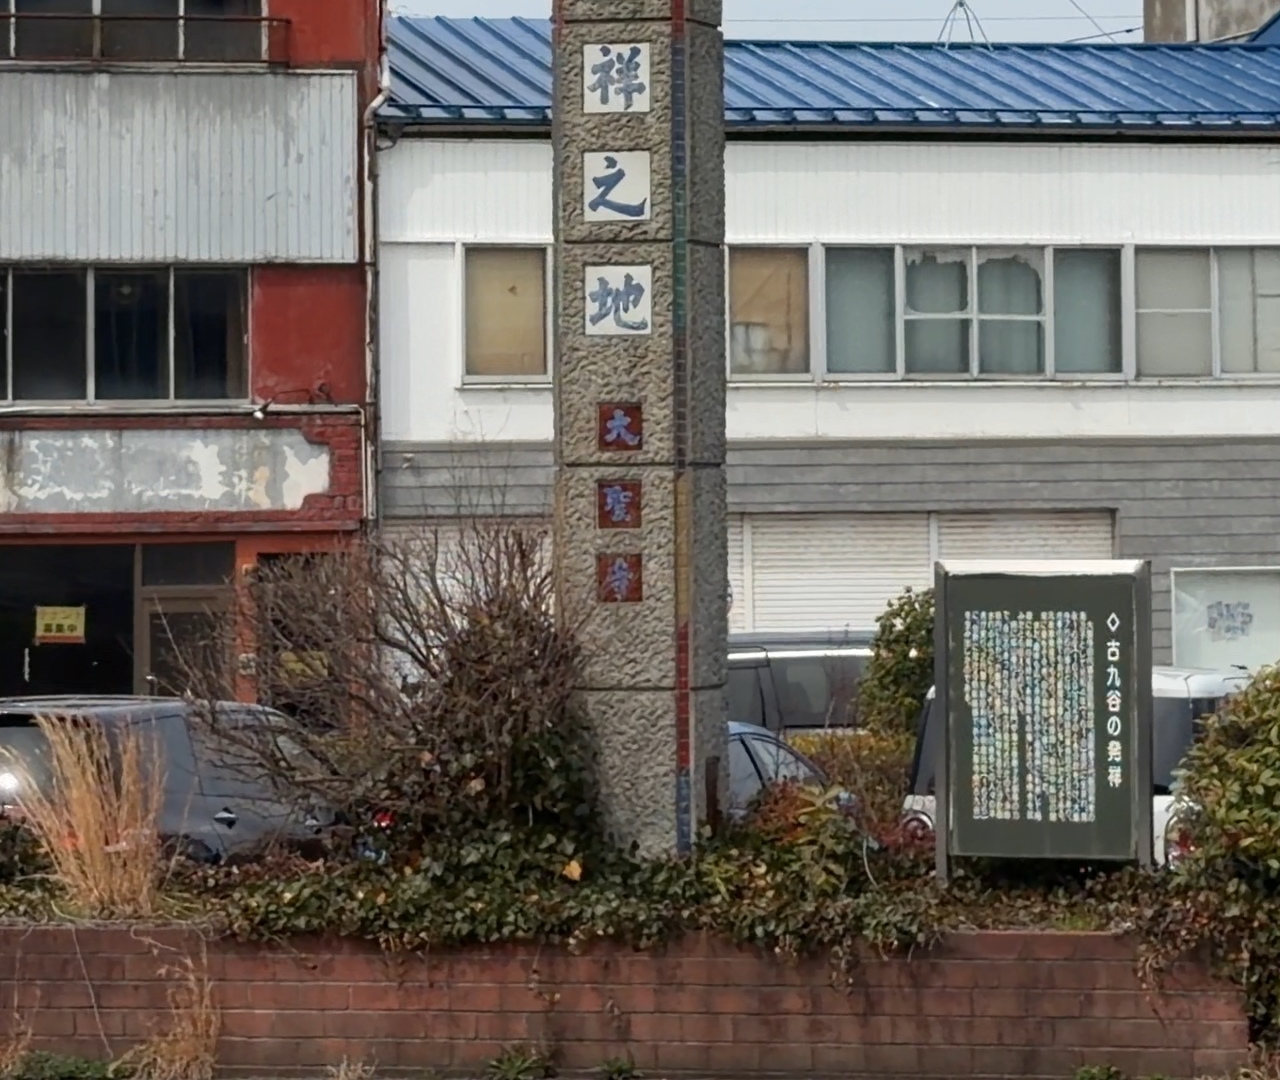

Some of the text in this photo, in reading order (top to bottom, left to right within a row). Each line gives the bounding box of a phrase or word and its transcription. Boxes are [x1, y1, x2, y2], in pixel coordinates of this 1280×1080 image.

[1106, 638, 1123, 788] 古九谷の発祥
